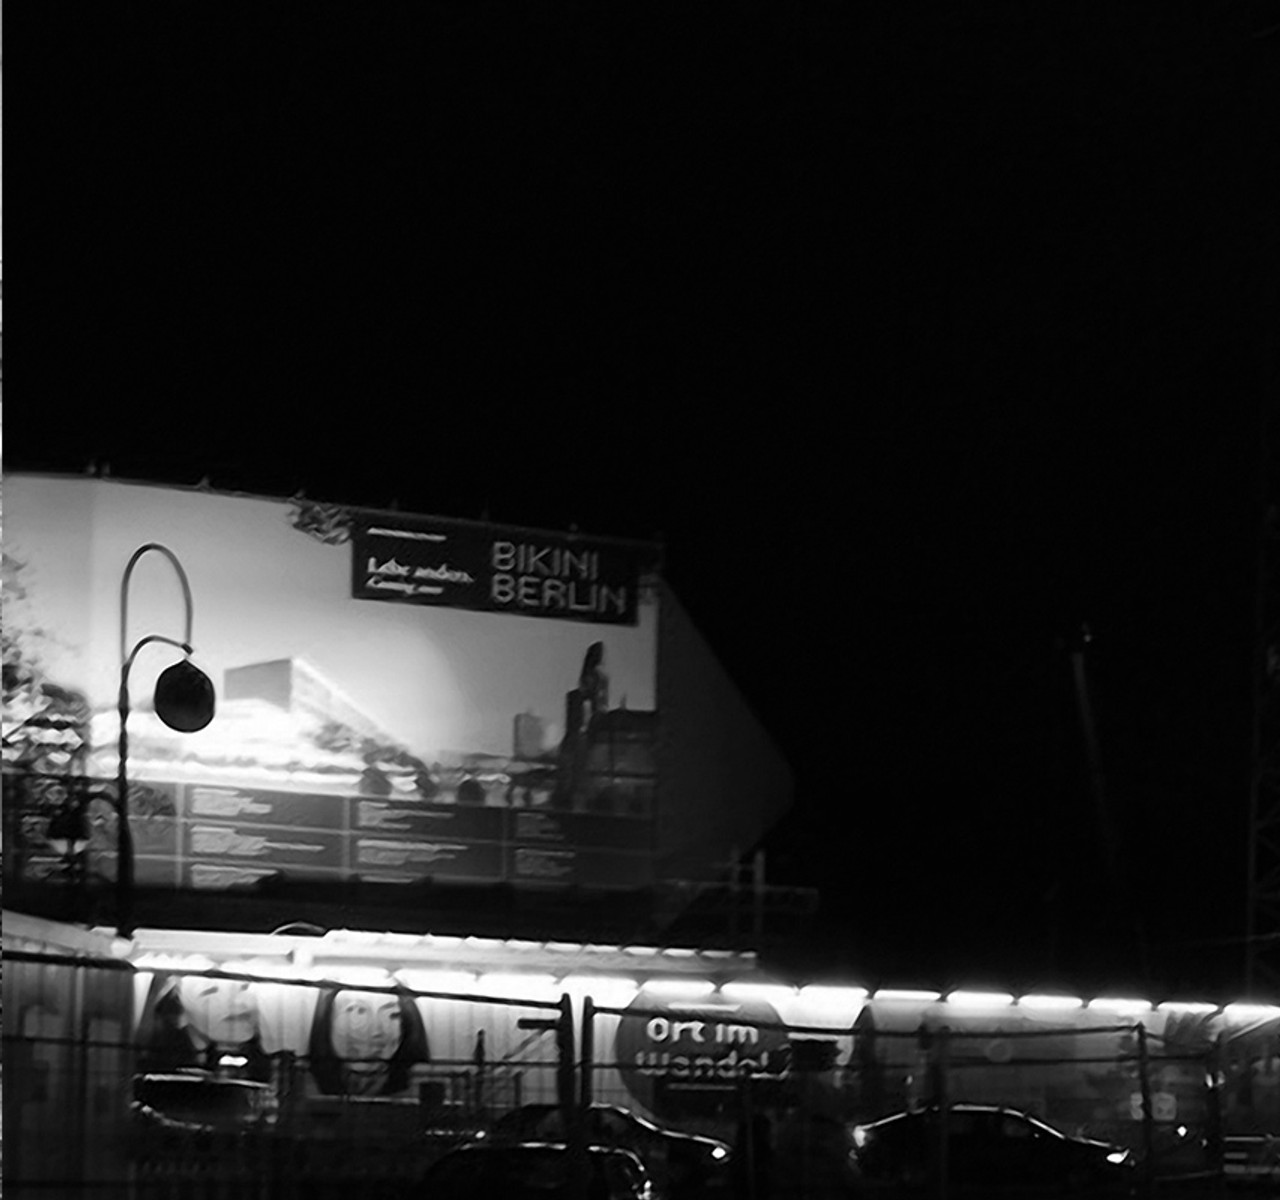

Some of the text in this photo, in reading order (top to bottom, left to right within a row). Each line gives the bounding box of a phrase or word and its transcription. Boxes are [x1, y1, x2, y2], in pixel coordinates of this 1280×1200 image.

[492, 541, 598, 580] BIKINI
[491, 573, 626, 614] BERLIN
[715, 1023, 759, 1044] im
